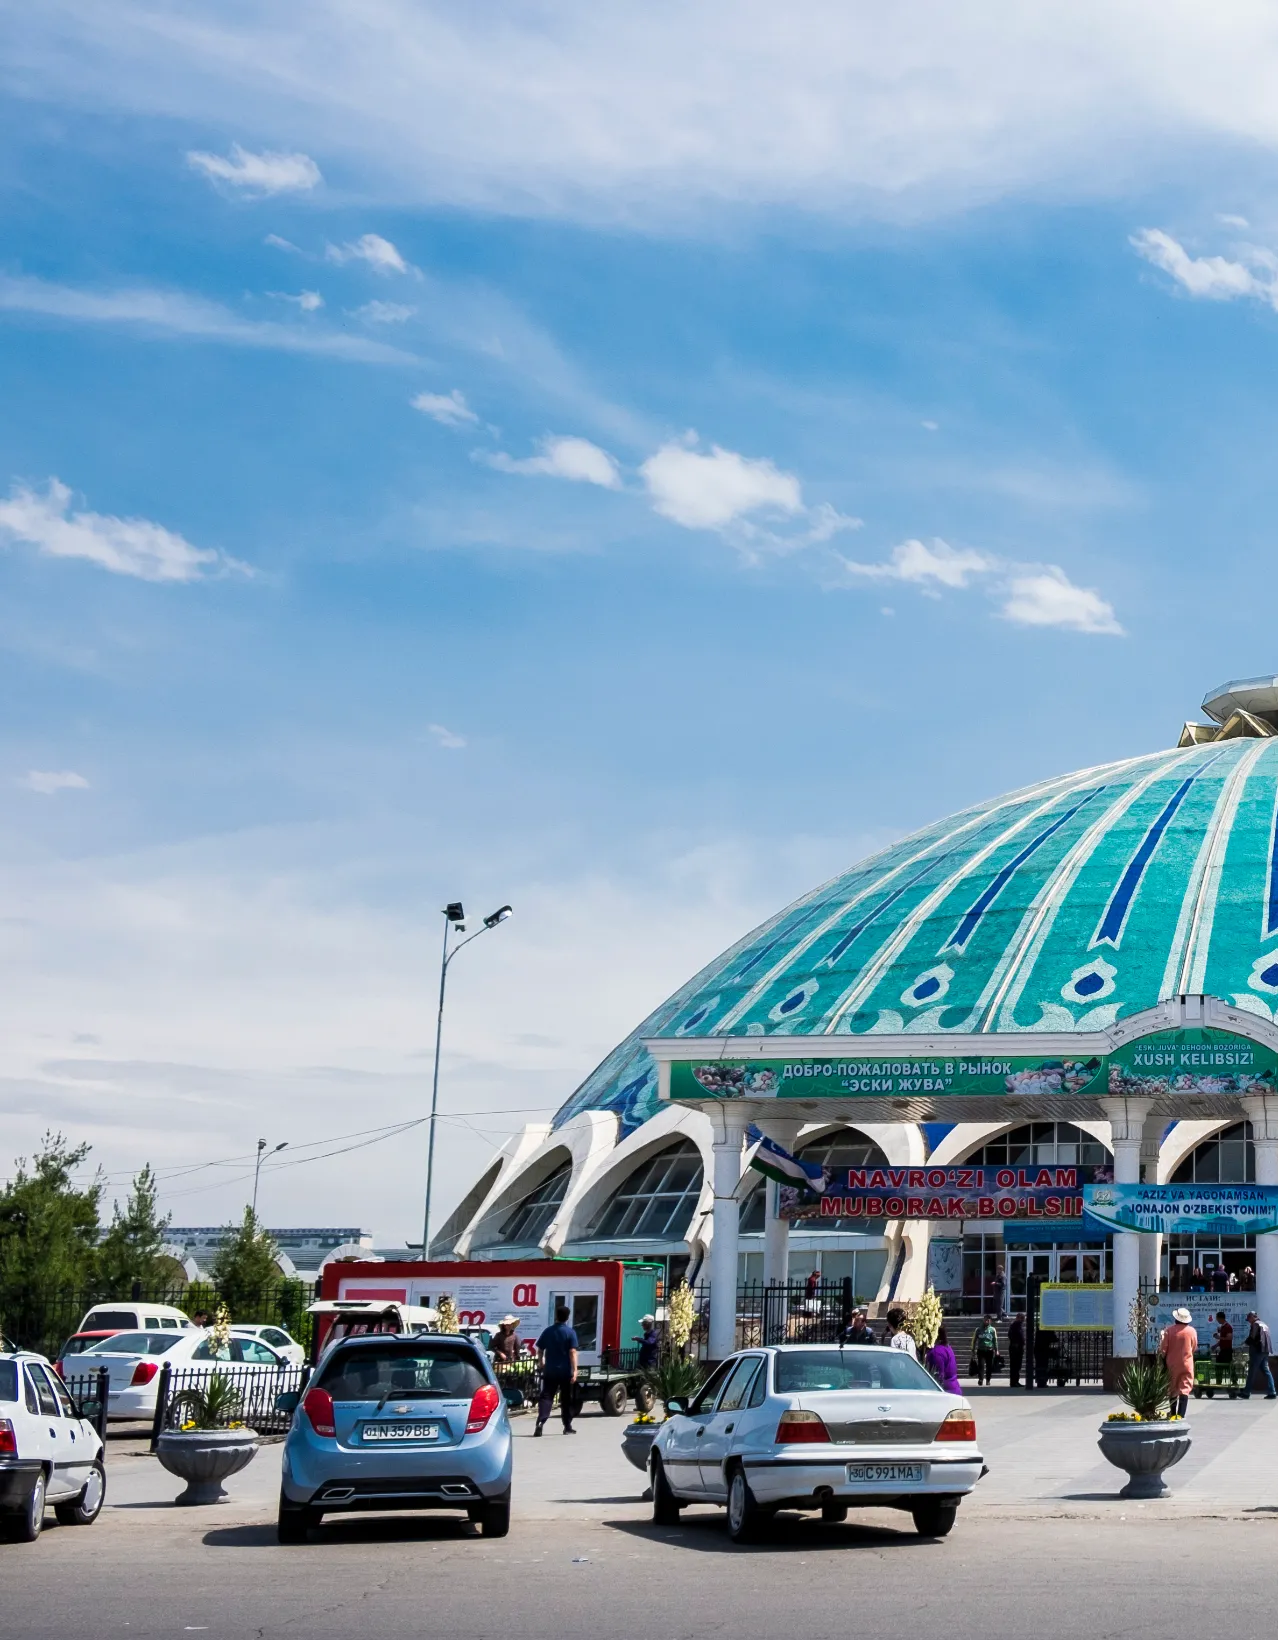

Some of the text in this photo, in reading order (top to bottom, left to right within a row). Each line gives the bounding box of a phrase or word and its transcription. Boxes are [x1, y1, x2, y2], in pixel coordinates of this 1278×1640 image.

[1213, 1043, 1252, 1051] BOZORIGA
[1133, 1052, 1254, 1066] XUSH KELIBSIZ!
[782, 1062, 1012, 1078] ДОБРО-ПОЖАЛОВАТЬ В РЫНОК
[841, 1078, 952, 1092] “ЭСКИ ЖУВА”
[848, 1168, 1077, 1189] NAVRO‘ZI OLAM
[1137, 1190, 1268, 1202] “AZIZ VA YAGONAMSAN,
[820, 1196, 966, 1217] MUBORAK
[1129, 1203, 1180, 1215] JONAJON
[513, 1283, 539, 1307] 01
